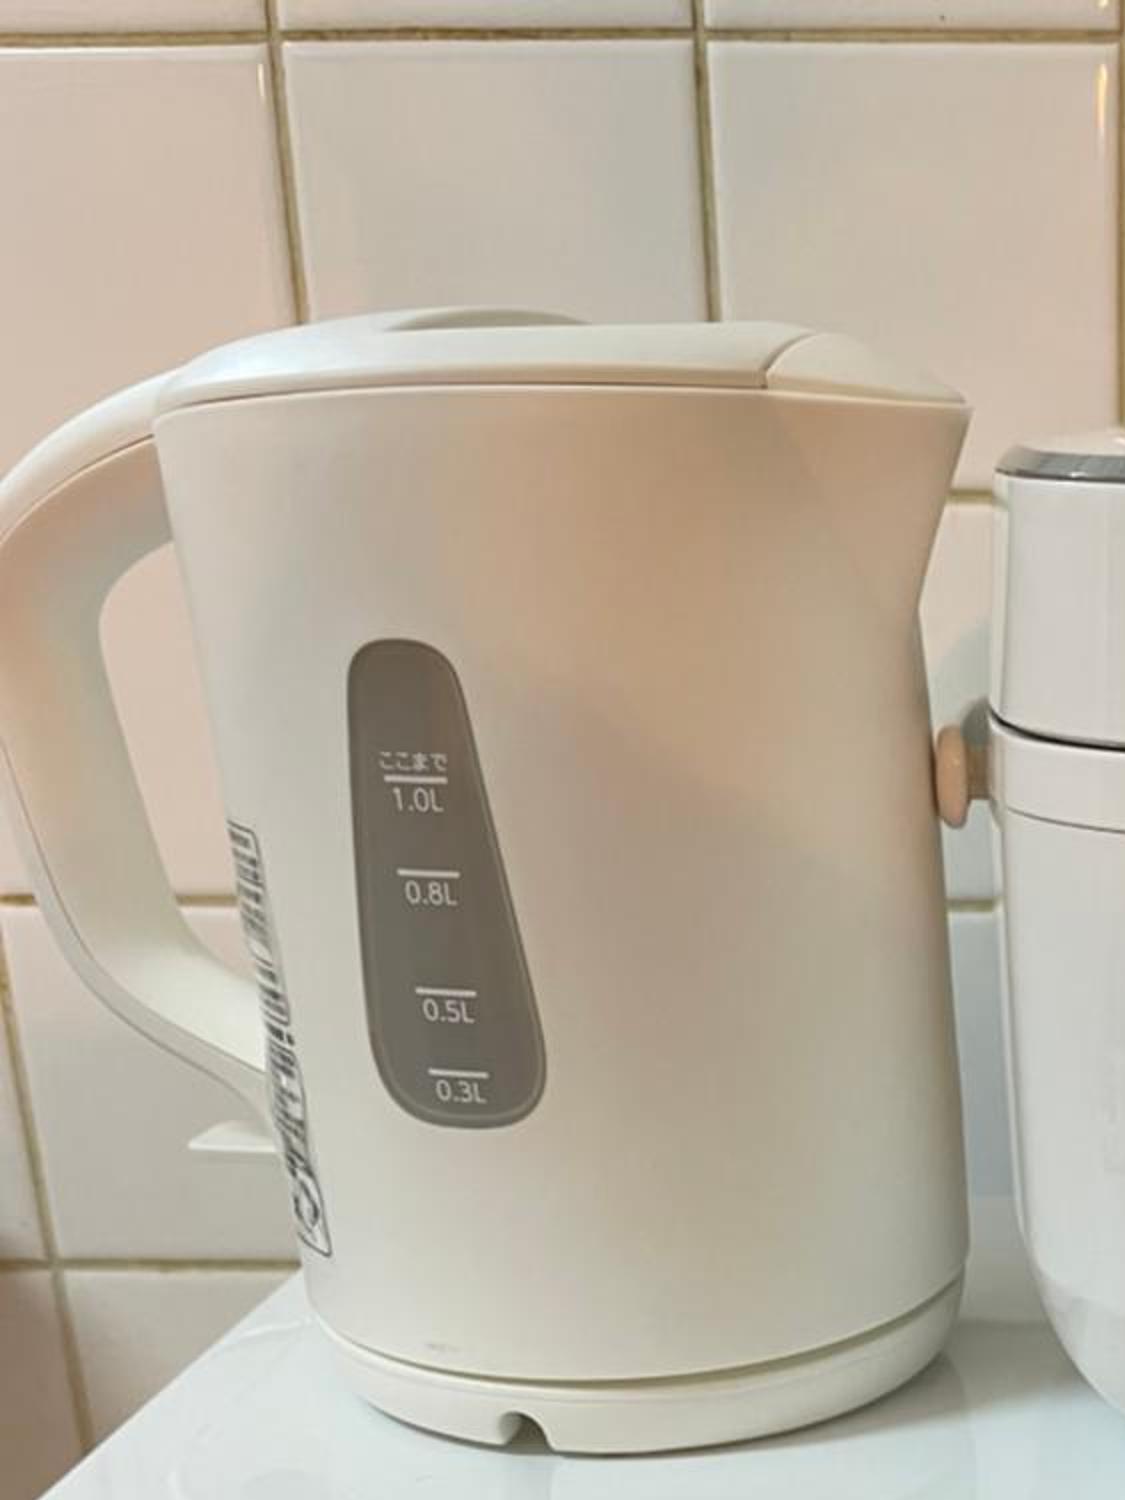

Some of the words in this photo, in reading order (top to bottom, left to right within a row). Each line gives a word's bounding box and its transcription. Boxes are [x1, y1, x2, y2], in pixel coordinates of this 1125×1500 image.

[379, 751, 448, 772] ここまで
[392, 786, 445, 813] 1.0L
[404, 879, 458, 906] 0.8L
[422, 998, 476, 1024] 0.5L
[435, 1078, 488, 1104] 0.3L
